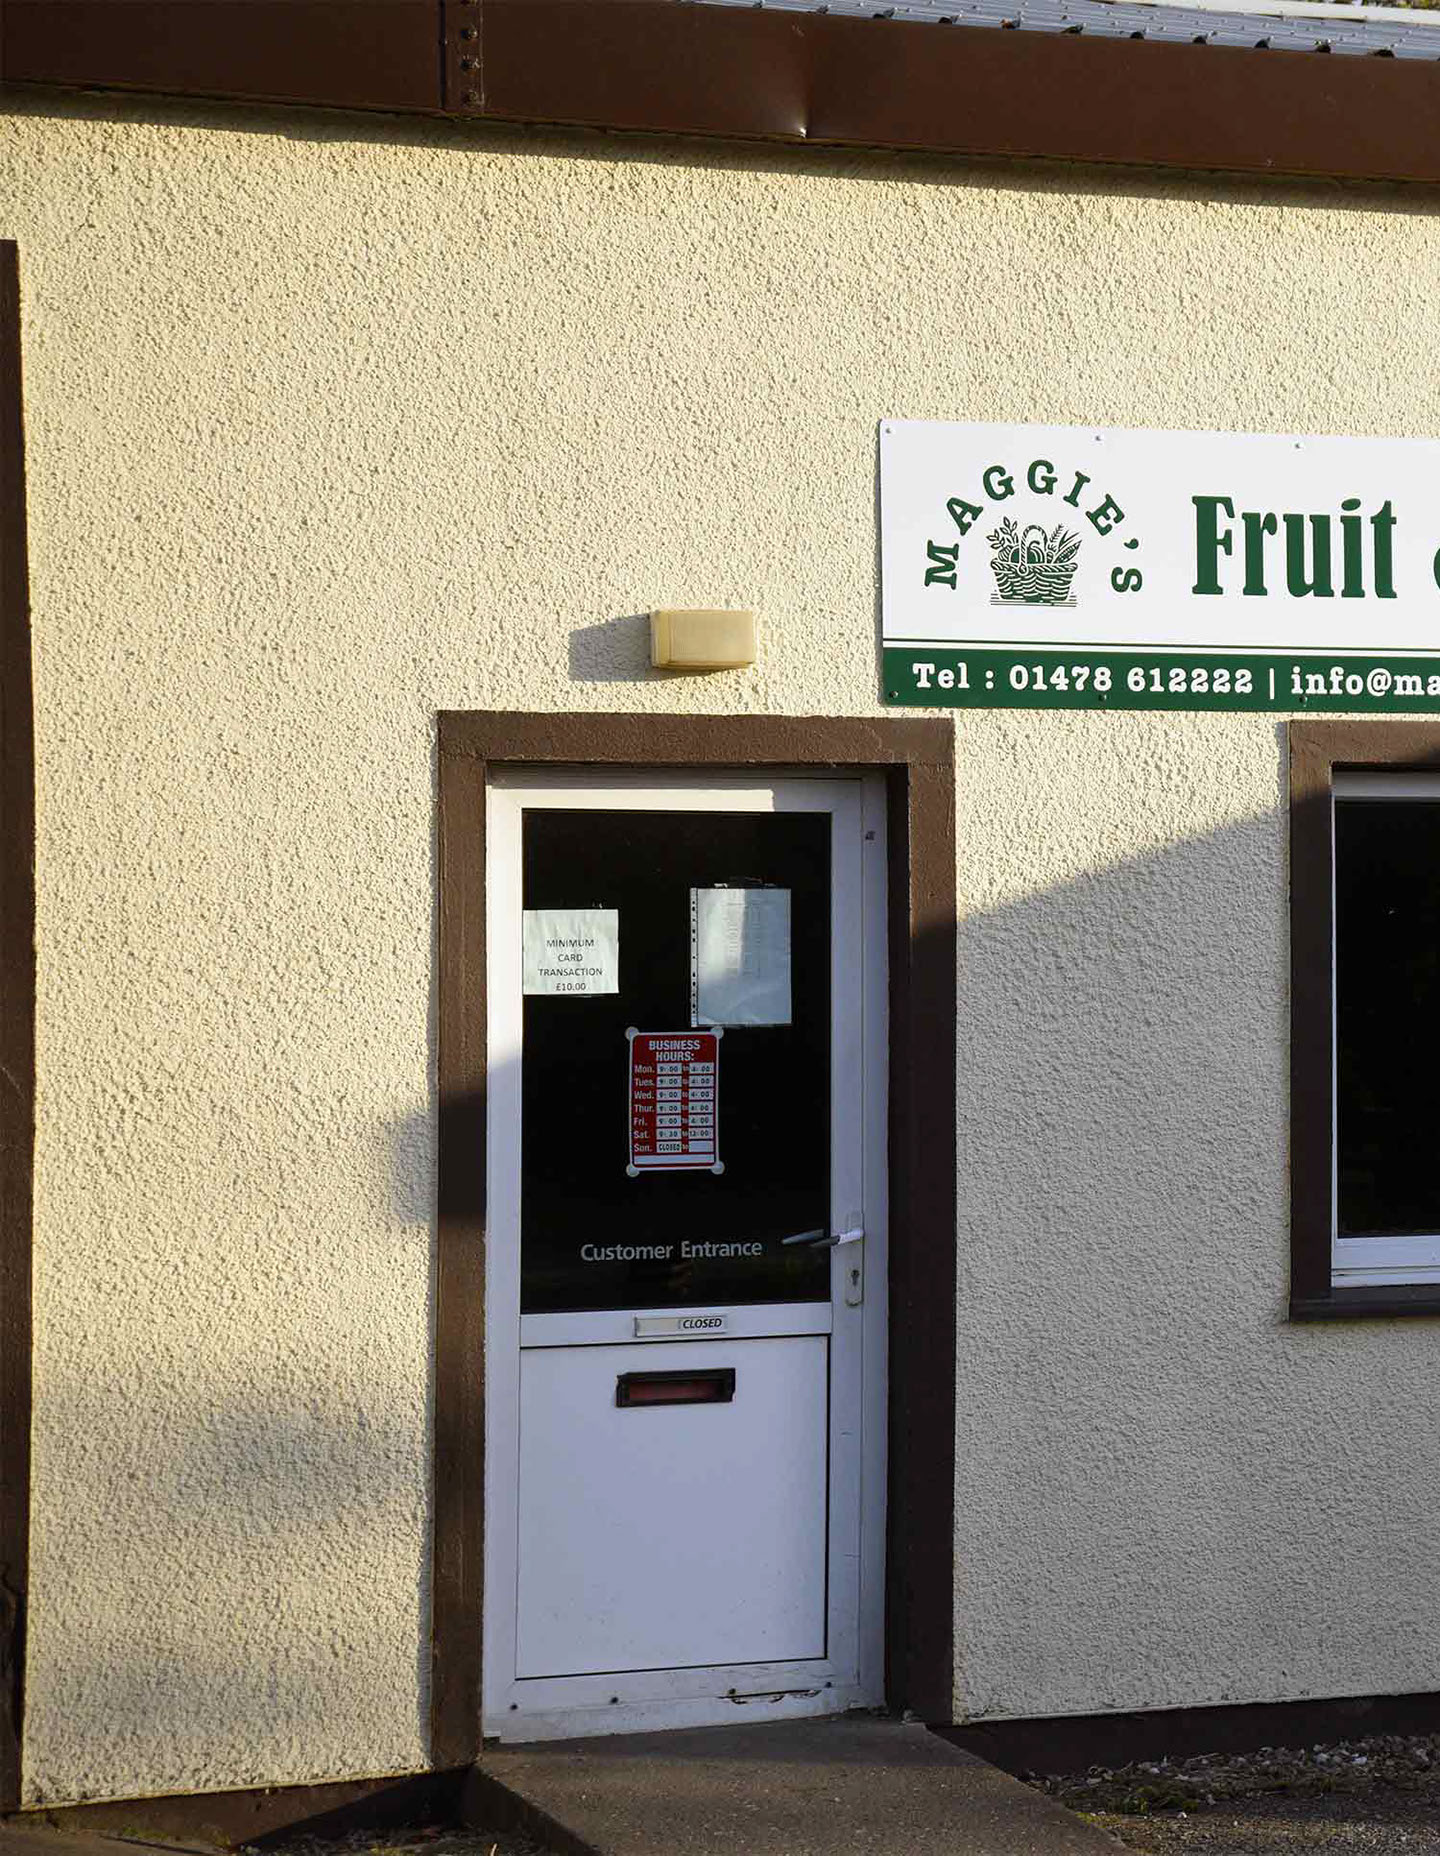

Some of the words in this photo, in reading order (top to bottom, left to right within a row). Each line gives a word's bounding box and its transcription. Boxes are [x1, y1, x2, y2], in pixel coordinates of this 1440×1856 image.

[924, 459, 1143, 594] MAGGIE'S
[1192, 495, 1398, 599] Fruit
[912, 662, 971, 690] Tel
[1009, 664, 1113, 692] 01478
[1126, 667, 1254, 693] 612222
[546, 939, 595, 948] MINIMUM
[557, 953, 584, 962] CARD
[538, 967, 603, 977] TRANSACTION
[555, 982, 587, 992] £10.00
[648, 1040, 701, 1051] BUSINESS
[655, 1051, 695, 1062] HOURS:
[634, 1064, 655, 1073] Mon.
[634, 1090, 655, 1099] Wed.
[633, 1117, 648, 1126] Fri.
[658, 1143, 681, 1151] CLOSED
[580, 1243, 674, 1262] Customer
[681, 1240, 763, 1259] Entrance
[682, 1317, 723, 1330] CLOSED
